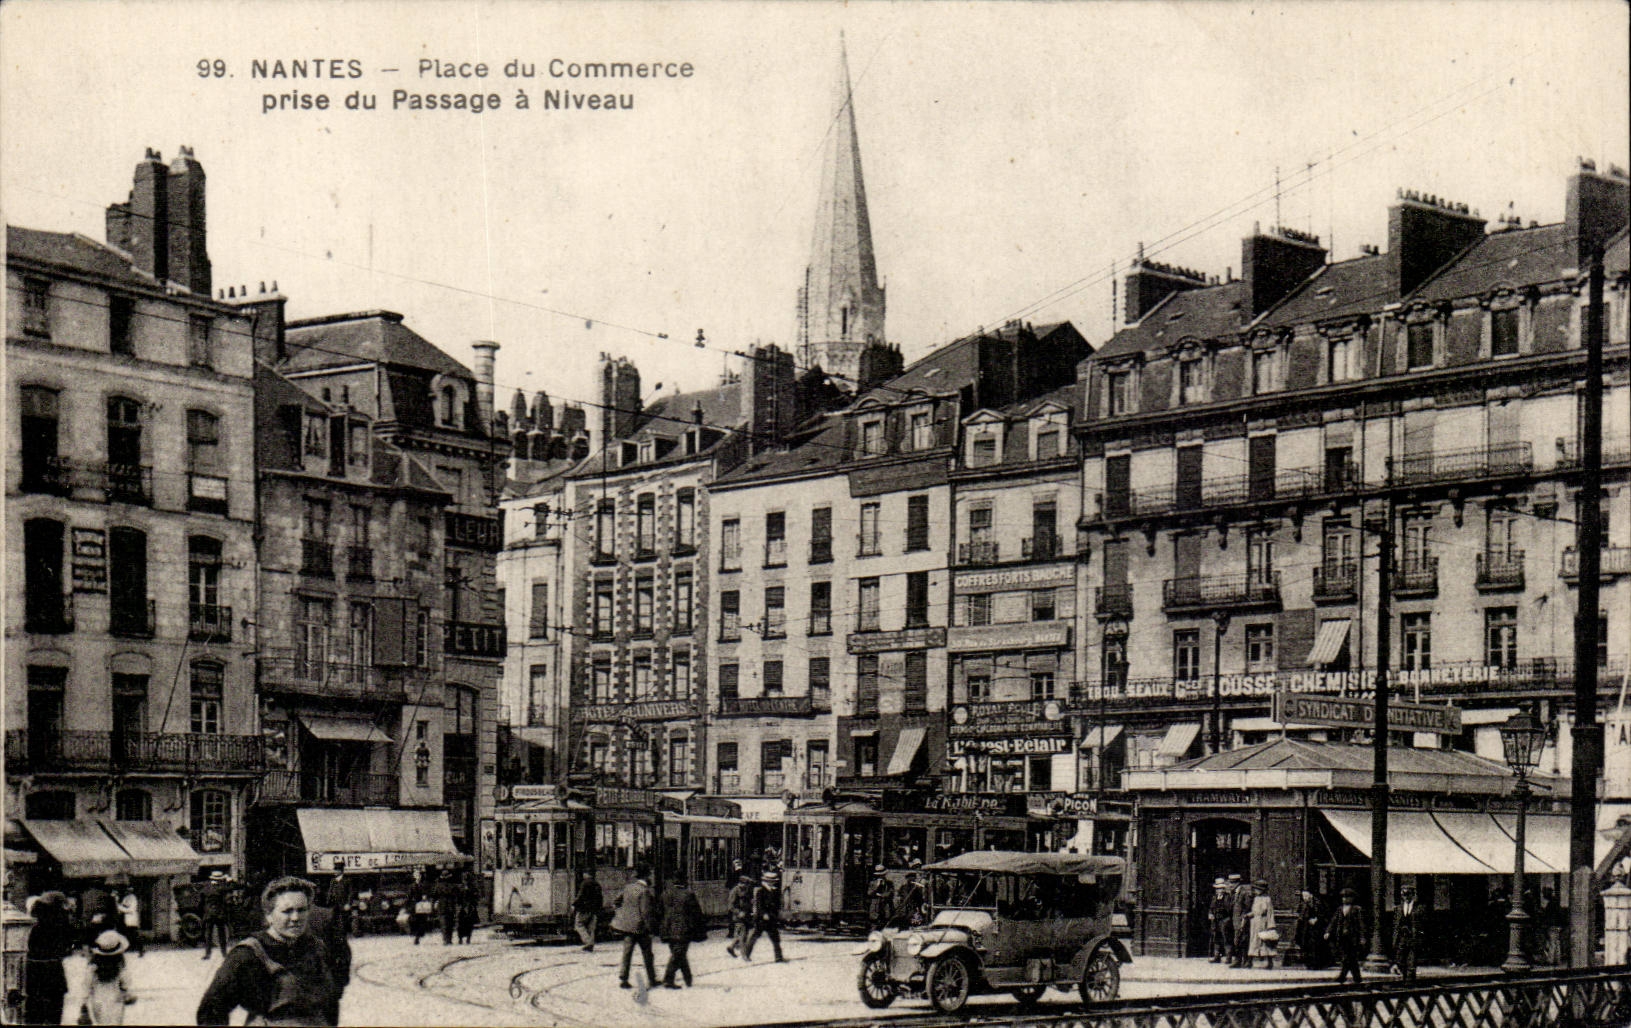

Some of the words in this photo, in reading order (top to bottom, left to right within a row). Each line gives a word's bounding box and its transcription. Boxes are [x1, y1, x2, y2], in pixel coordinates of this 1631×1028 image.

[444, 517, 500, 545] LEUR
[1087, 682, 1171, 700] TROUSEAUX
[1297, 702, 1355, 720] SYNDICAT
[1364, 707, 1444, 728] DNITIATIVE
[1064, 798, 1097, 813] PICON
